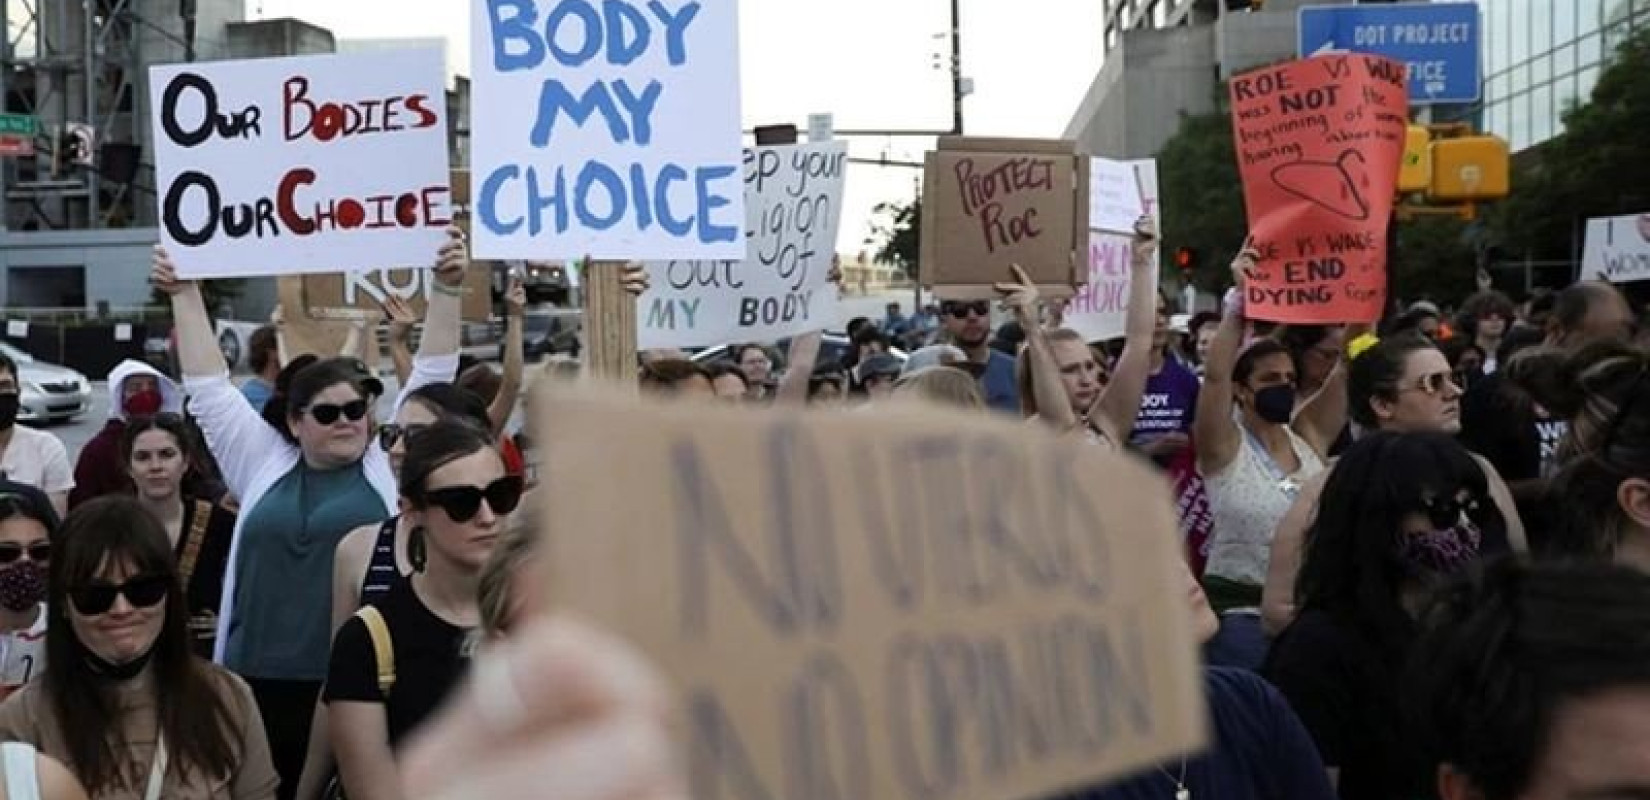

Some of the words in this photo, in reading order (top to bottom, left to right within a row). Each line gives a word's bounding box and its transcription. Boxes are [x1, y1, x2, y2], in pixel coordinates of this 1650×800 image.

[487, 0, 700, 71] BODY
[1354, 25, 1386, 46] DOT
[1393, 22, 1469, 44] PROJECT
[1234, 67, 1293, 102] ROE
[1279, 84, 1341, 116] NOT
[162, 73, 260, 147] OUR
[283, 76, 437, 142] BODIES
[530, 78, 662, 147] MY
[1240, 114, 1328, 145] beginning
[1344, 104, 1362, 121] of
[786, 148, 846, 197] your
[1243, 141, 1303, 165] having
[163, 170, 279, 246] OUR
[277, 168, 450, 236] CHOICE
[477, 160, 737, 243] CHOICE
[954, 157, 1055, 216] PROTECT
[778, 231, 815, 291] of
[1284, 256, 1346, 284] END
[646, 297, 701, 330] MY
[739, 292, 813, 327] BODY
[1249, 284, 1333, 306] DYING
